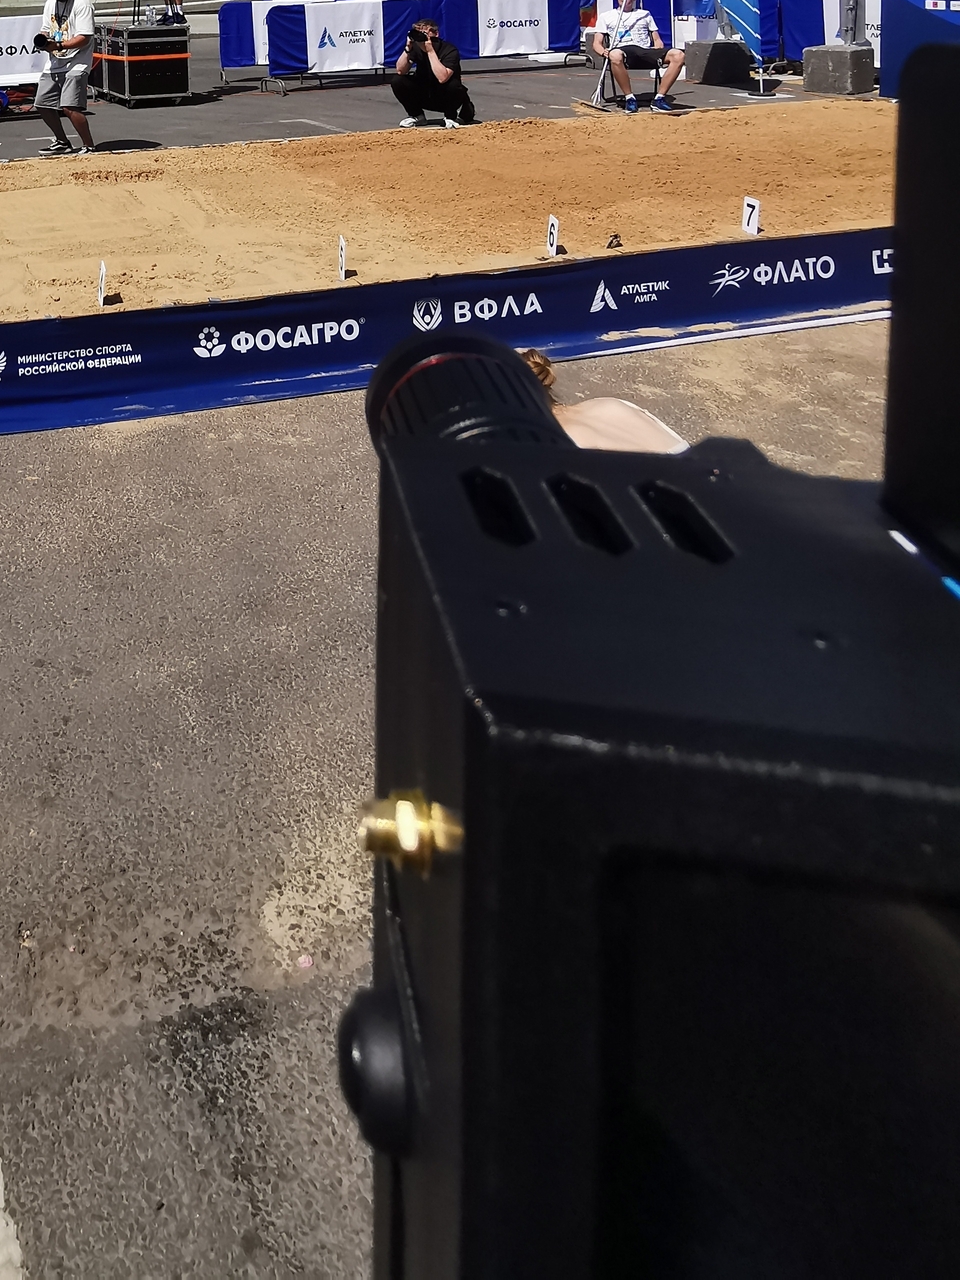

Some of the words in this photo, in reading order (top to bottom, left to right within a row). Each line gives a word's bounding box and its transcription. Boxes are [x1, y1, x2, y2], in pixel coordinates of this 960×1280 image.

[338, 29, 375, 38] АТЛЕТИК
[499, 19, 540, 28] ФОСАГРО
[746, 203, 756, 227] 7
[548, 222, 556, 248] 6
[753, 255, 835, 286] ФЛАТО
[620, 280, 670, 295] АТЛЕТИК
[634, 293, 658, 303] ЛИГА
[453, 292, 543, 324] ВФЛА
[231, 318, 360, 354] ФОСАГРО
[17, 347, 94, 365] МИНИСТЕРСТВО
[95, 343, 133, 355] СПОРТА
[18, 358, 85, 377] РОССИЙСКОЙ
[86, 354, 142, 369] ФЕДЕРАЦИИ
